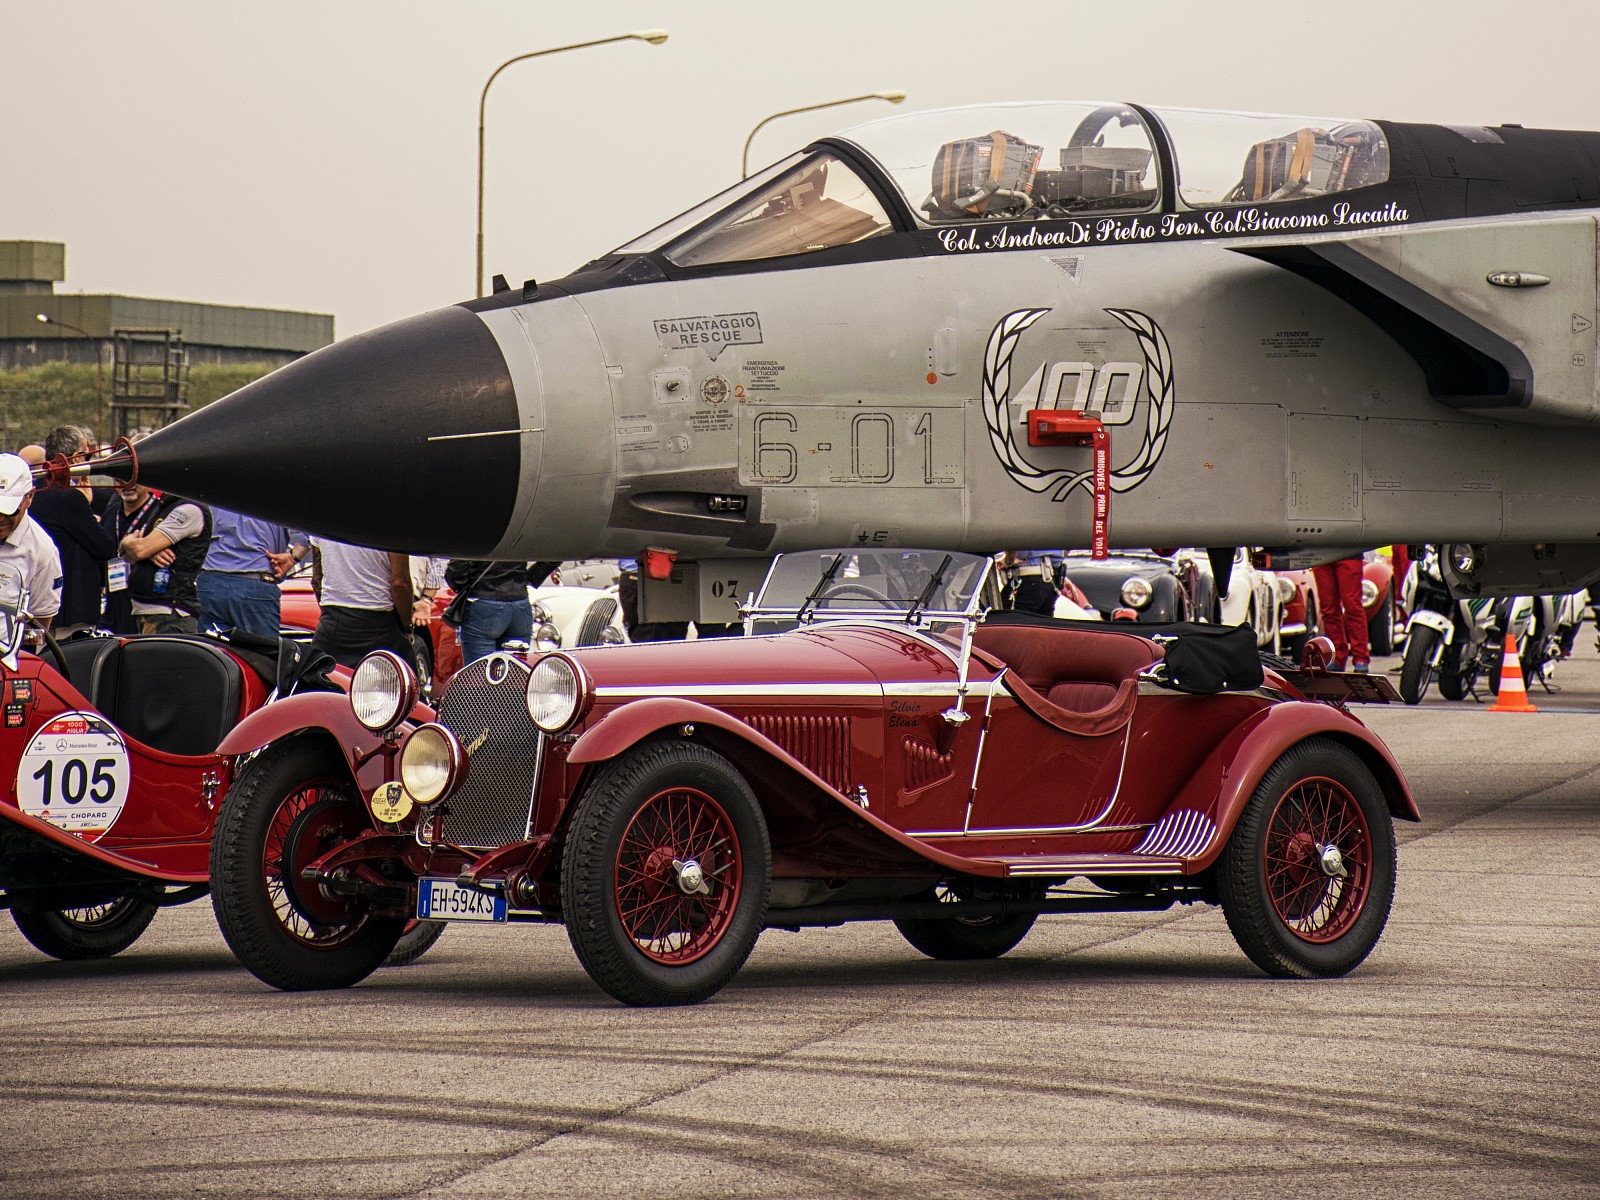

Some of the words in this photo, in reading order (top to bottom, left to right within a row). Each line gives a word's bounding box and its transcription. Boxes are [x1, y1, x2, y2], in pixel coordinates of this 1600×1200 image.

[938, 228, 981, 251] Col.
[1096, 218, 1156, 242] Pietro
[1161, 213, 1205, 237] Ten.
[1333, 201, 1409, 225] Lacaita
[659, 317, 756, 334] SALVATAGGIO
[679, 330, 742, 345] RESCUE
[753, 411, 933, 484] 6-01
[1097, 450, 1106, 491] RIMUOVERE
[1097, 494, 1106, 518] PRIMA
[1095, 520, 1104, 535] DEL
[1095, 537, 1104, 557] VOLO
[711, 580, 739, 598] 07
[889, 700, 921, 713] Silvio
[888, 715, 918, 728] Elena
[33, 758, 116, 806] 105
